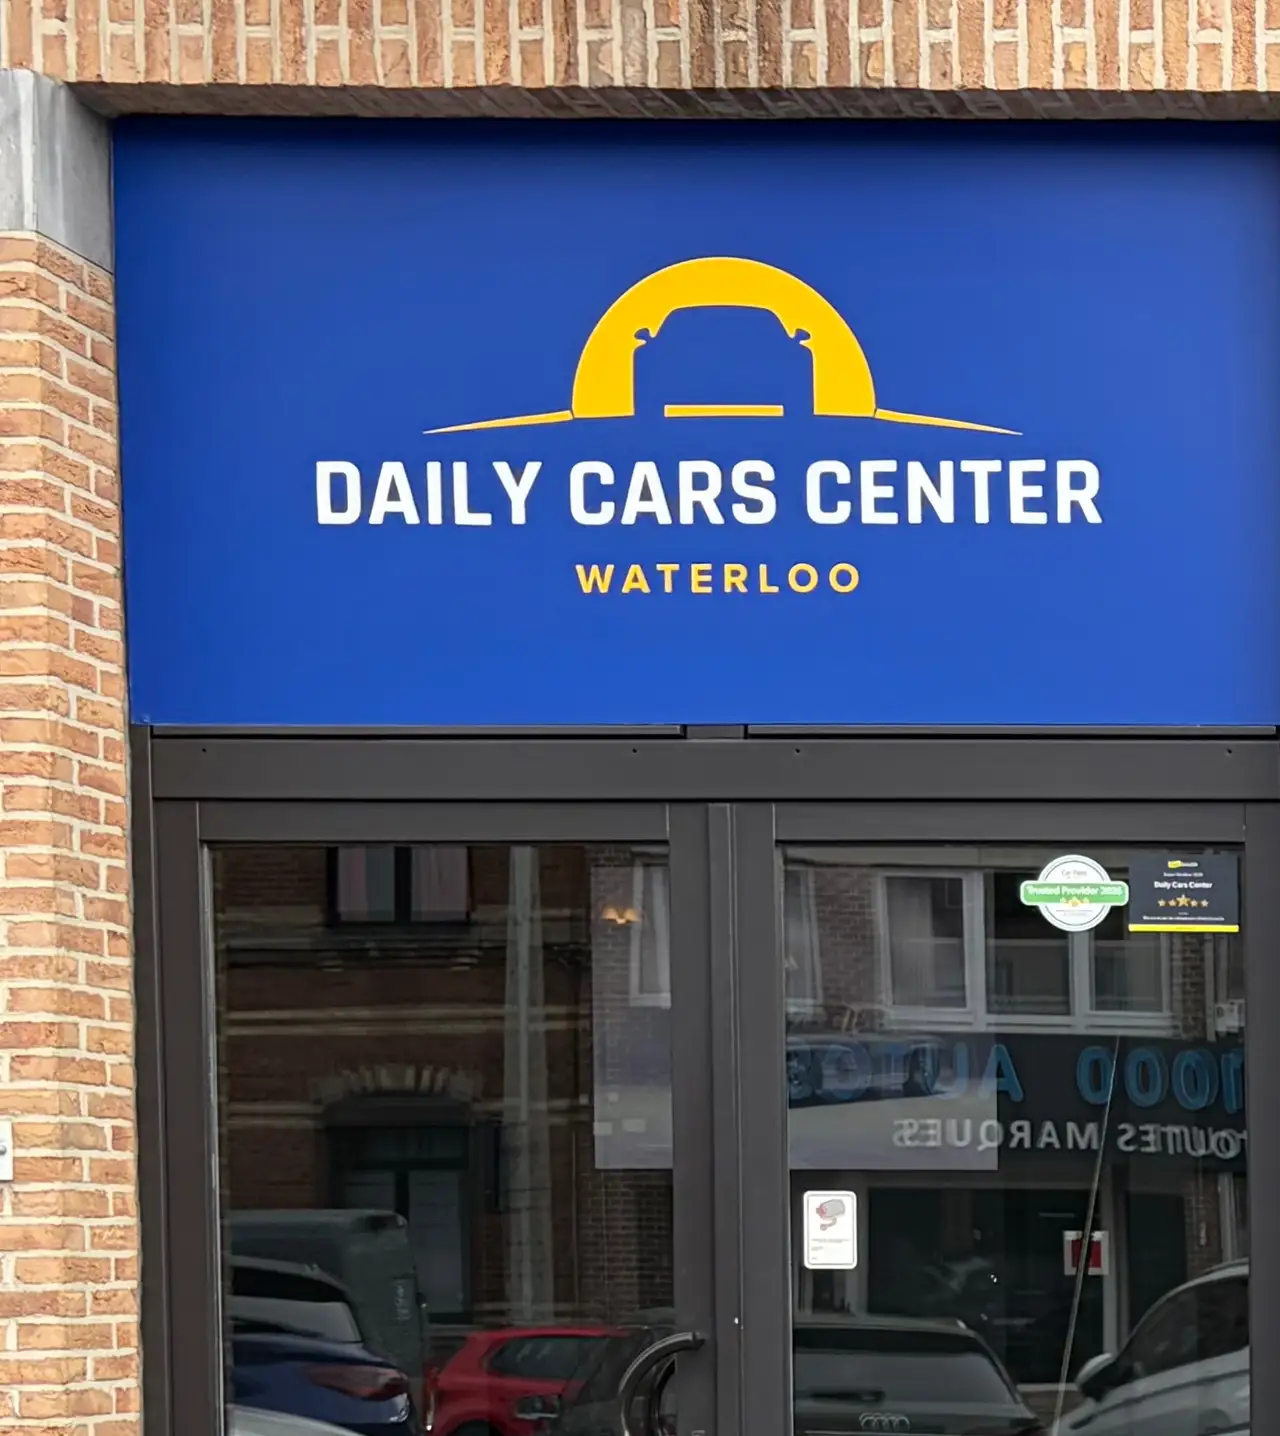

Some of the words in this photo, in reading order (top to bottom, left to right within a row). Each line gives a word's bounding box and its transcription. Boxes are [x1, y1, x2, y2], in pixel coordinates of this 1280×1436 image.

[316, 461, 542, 525] DAILY
[570, 460, 776, 525] CARS
[807, 460, 1102, 524] CENTER
[576, 563, 859, 593] WATERLOO
[1153, 881, 1171, 890] Daily
[1172, 881, 1188, 889] Cars
[1188, 881, 1213, 889] Center
